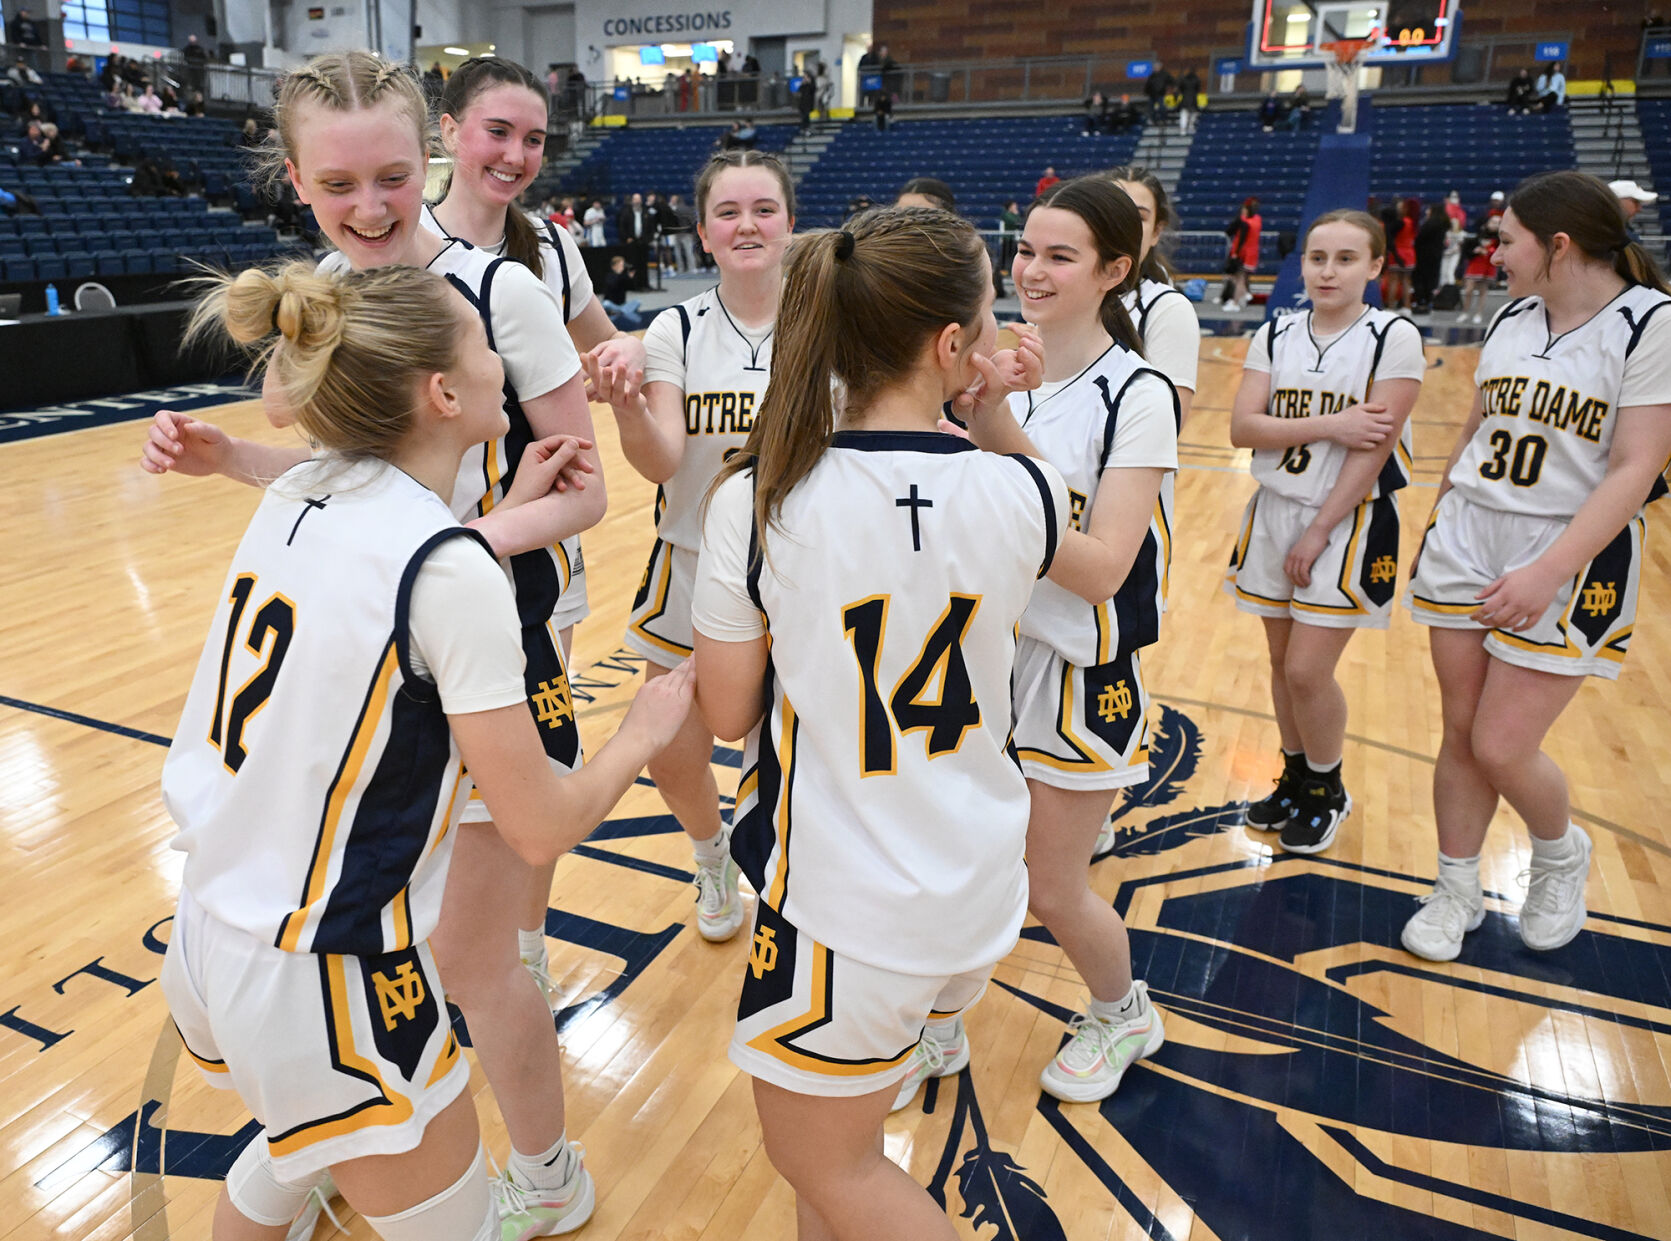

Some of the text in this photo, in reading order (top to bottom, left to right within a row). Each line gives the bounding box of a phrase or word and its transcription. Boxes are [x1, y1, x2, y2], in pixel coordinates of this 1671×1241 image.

[603, 11, 732, 36] CONCESSIONS
[686, 391, 755, 436] OTRE
[1272, 388, 1313, 418] TRE
[1528, 379, 1610, 443] DAME
[1478, 428, 1548, 488] 30
[206, 571, 297, 778] 12
[840, 591, 983, 780] 14
